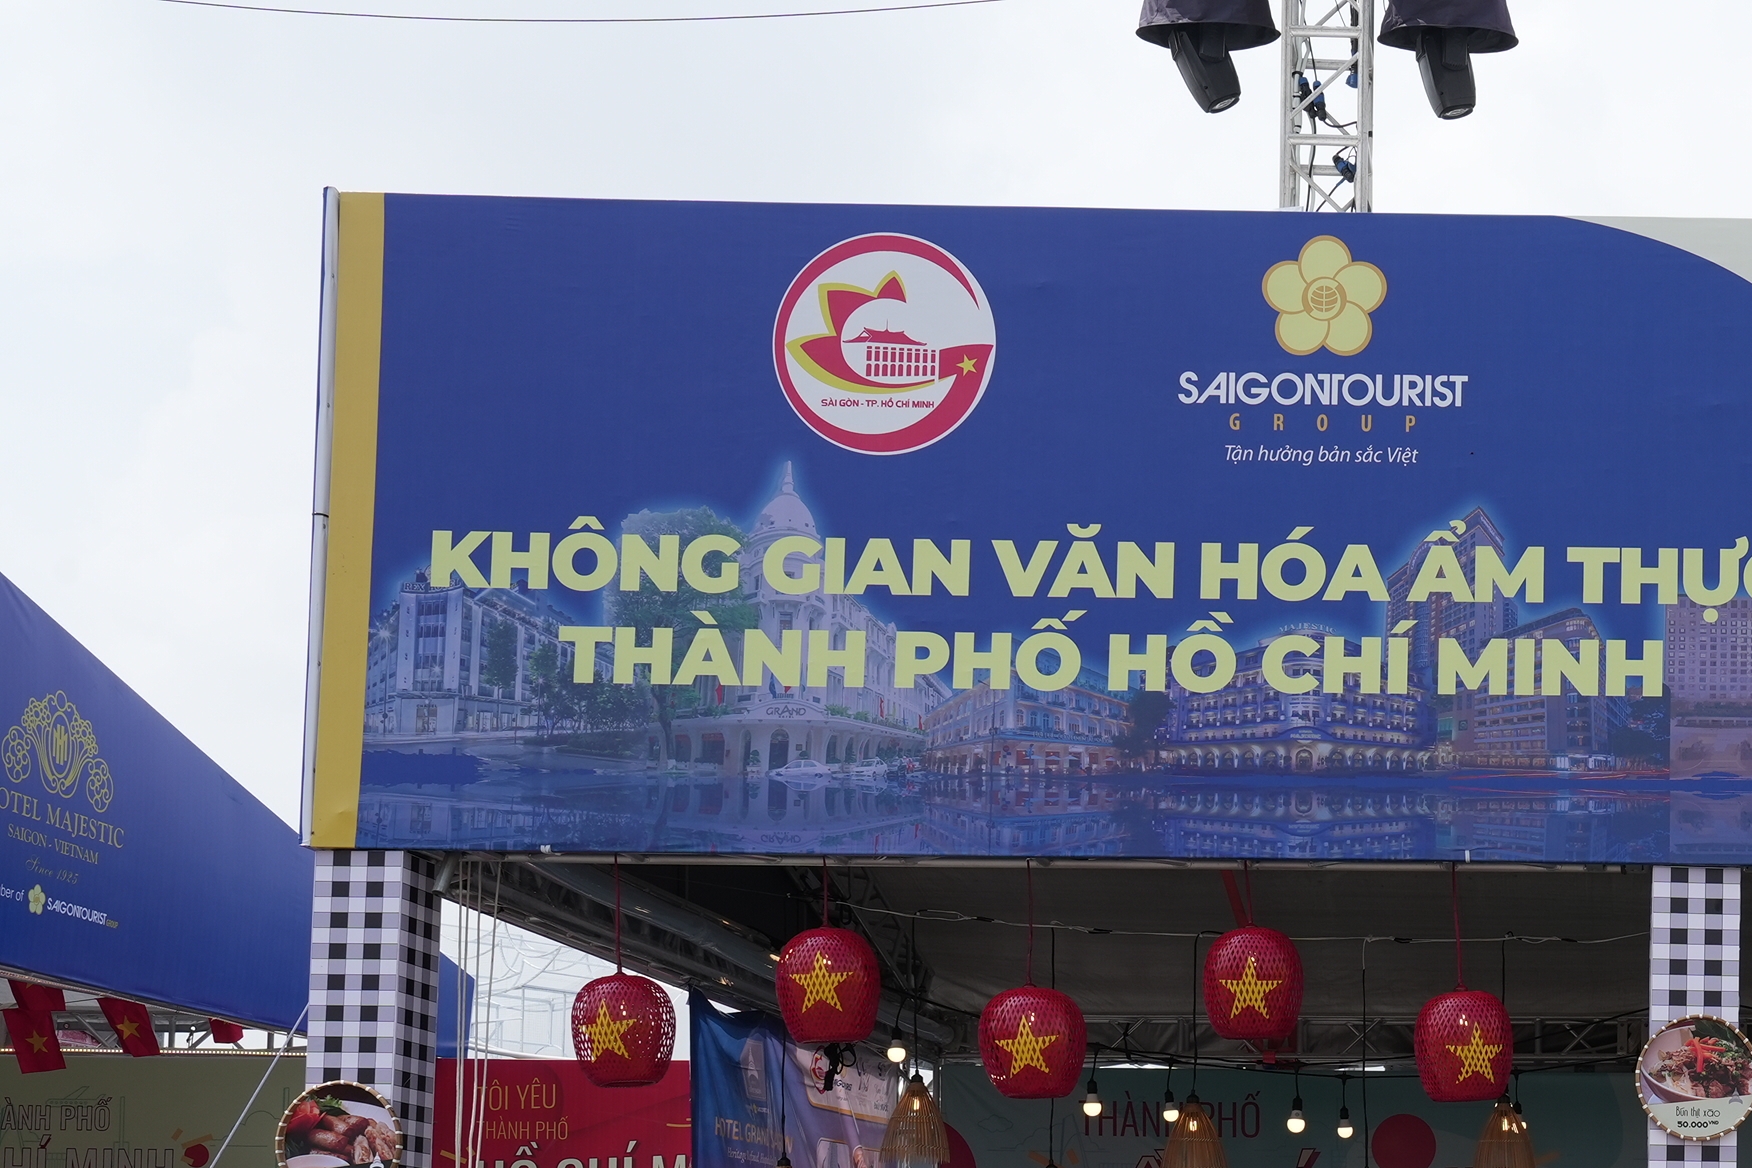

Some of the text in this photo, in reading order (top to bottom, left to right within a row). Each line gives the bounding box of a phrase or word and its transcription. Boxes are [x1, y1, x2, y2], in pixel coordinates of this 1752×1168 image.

[821, 397, 935, 409] SÀI GÒN HỒ CHÍ MINH
[1178, 371, 1469, 408] SAIGONTOURIST
[1229, 412, 1417, 433] GROUP
[1224, 445, 1419, 467] Tận hưởng bản sắc Việt
[431, 515, 741, 594] KHÔNG
[762, 536, 970, 597] GIAN
[993, 523, 1175, 599] VĂN
[1203, 526, 1387, 602] HÓA
[1408, 519, 1544, 604] ẨM
[558, 610, 1664, 698] THÀNH PHỐ HỒ CHÍ MINH
[46, 803, 125, 849] MAJESTIC
[7, 823, 99, 866] SAIGON VIETNAM
[25, 854, 54, 878] Since
[47, 898, 107, 926] SAIGONTOURIST
[516, 1077, 557, 1110] YÊU
[60, 1096, 113, 1131] PHỐ
[1675, 1105, 1688, 1117] Bún
[535, 1115, 569, 1141] PHỐ
